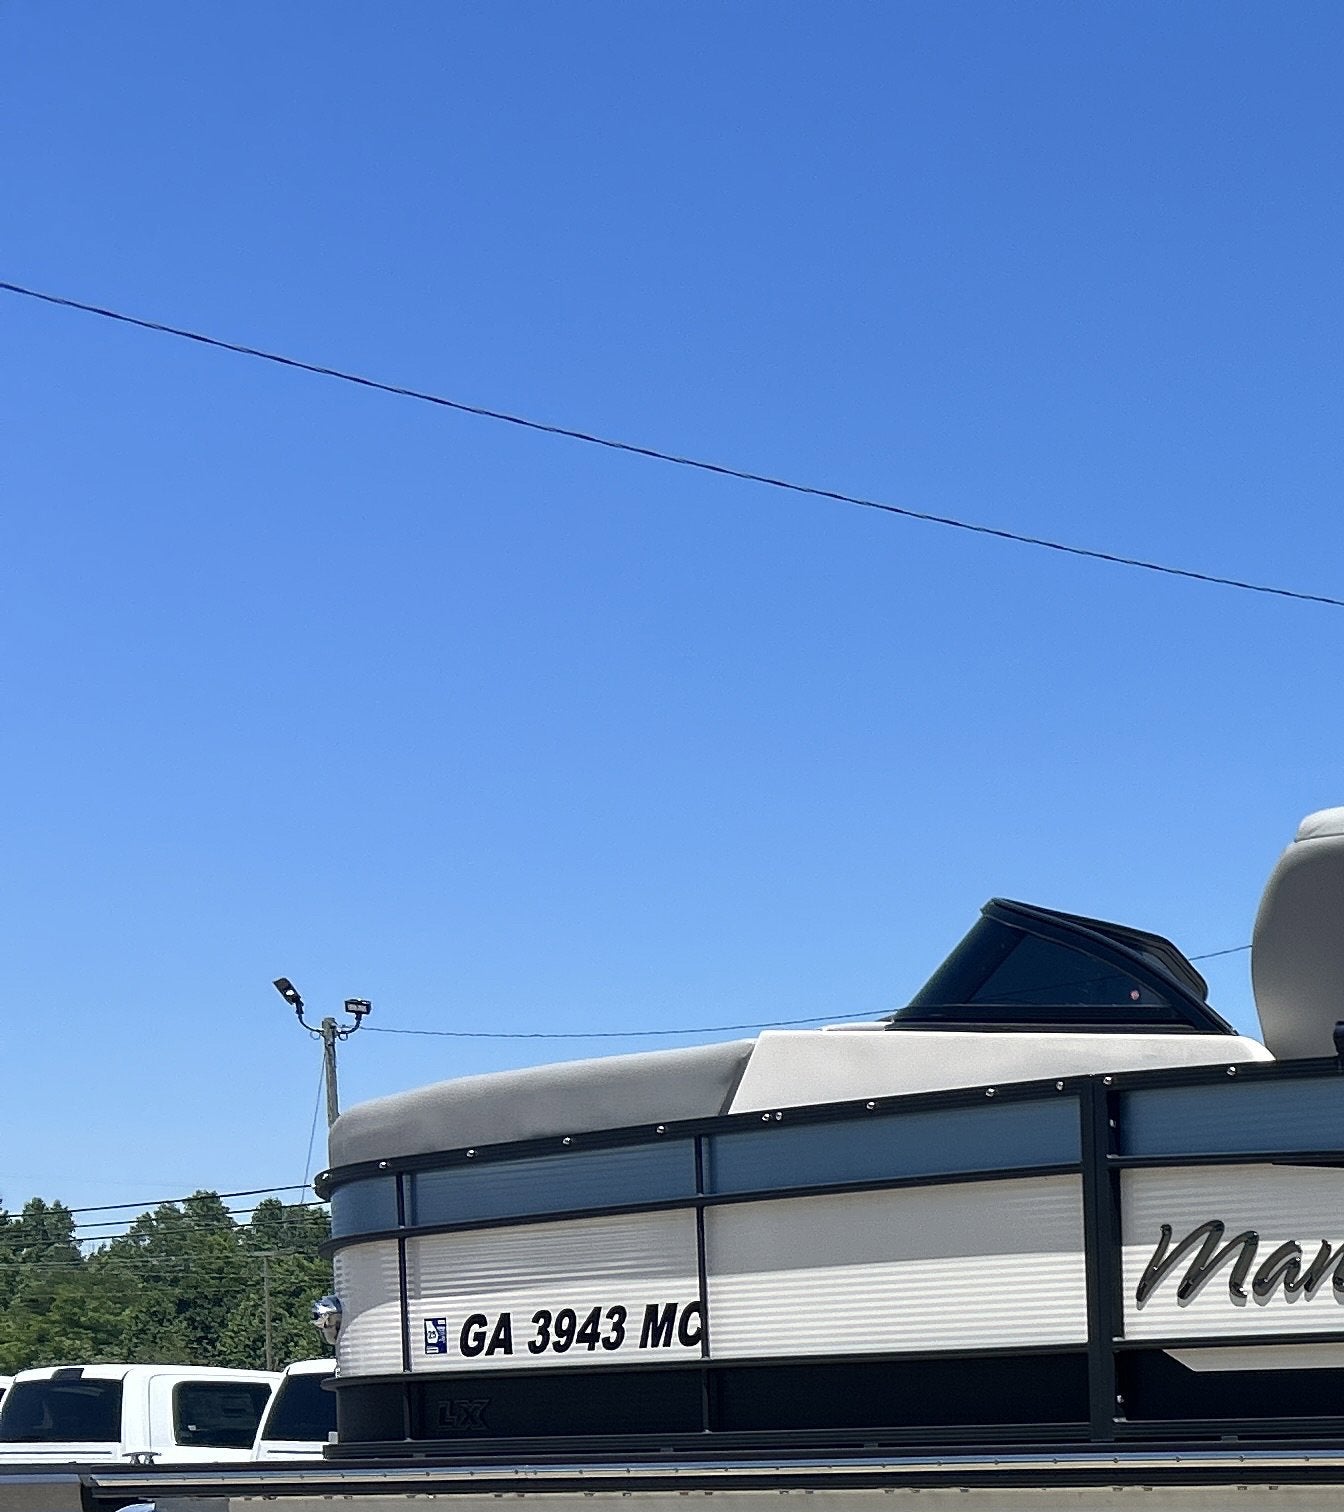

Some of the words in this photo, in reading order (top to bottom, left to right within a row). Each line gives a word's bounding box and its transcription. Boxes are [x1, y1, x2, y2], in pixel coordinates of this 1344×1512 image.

[459, 1312, 514, 1358] GA
[527, 1304, 628, 1355] 3943
[639, 1300, 703, 1350] MC
[436, 1399, 490, 1431] LX
